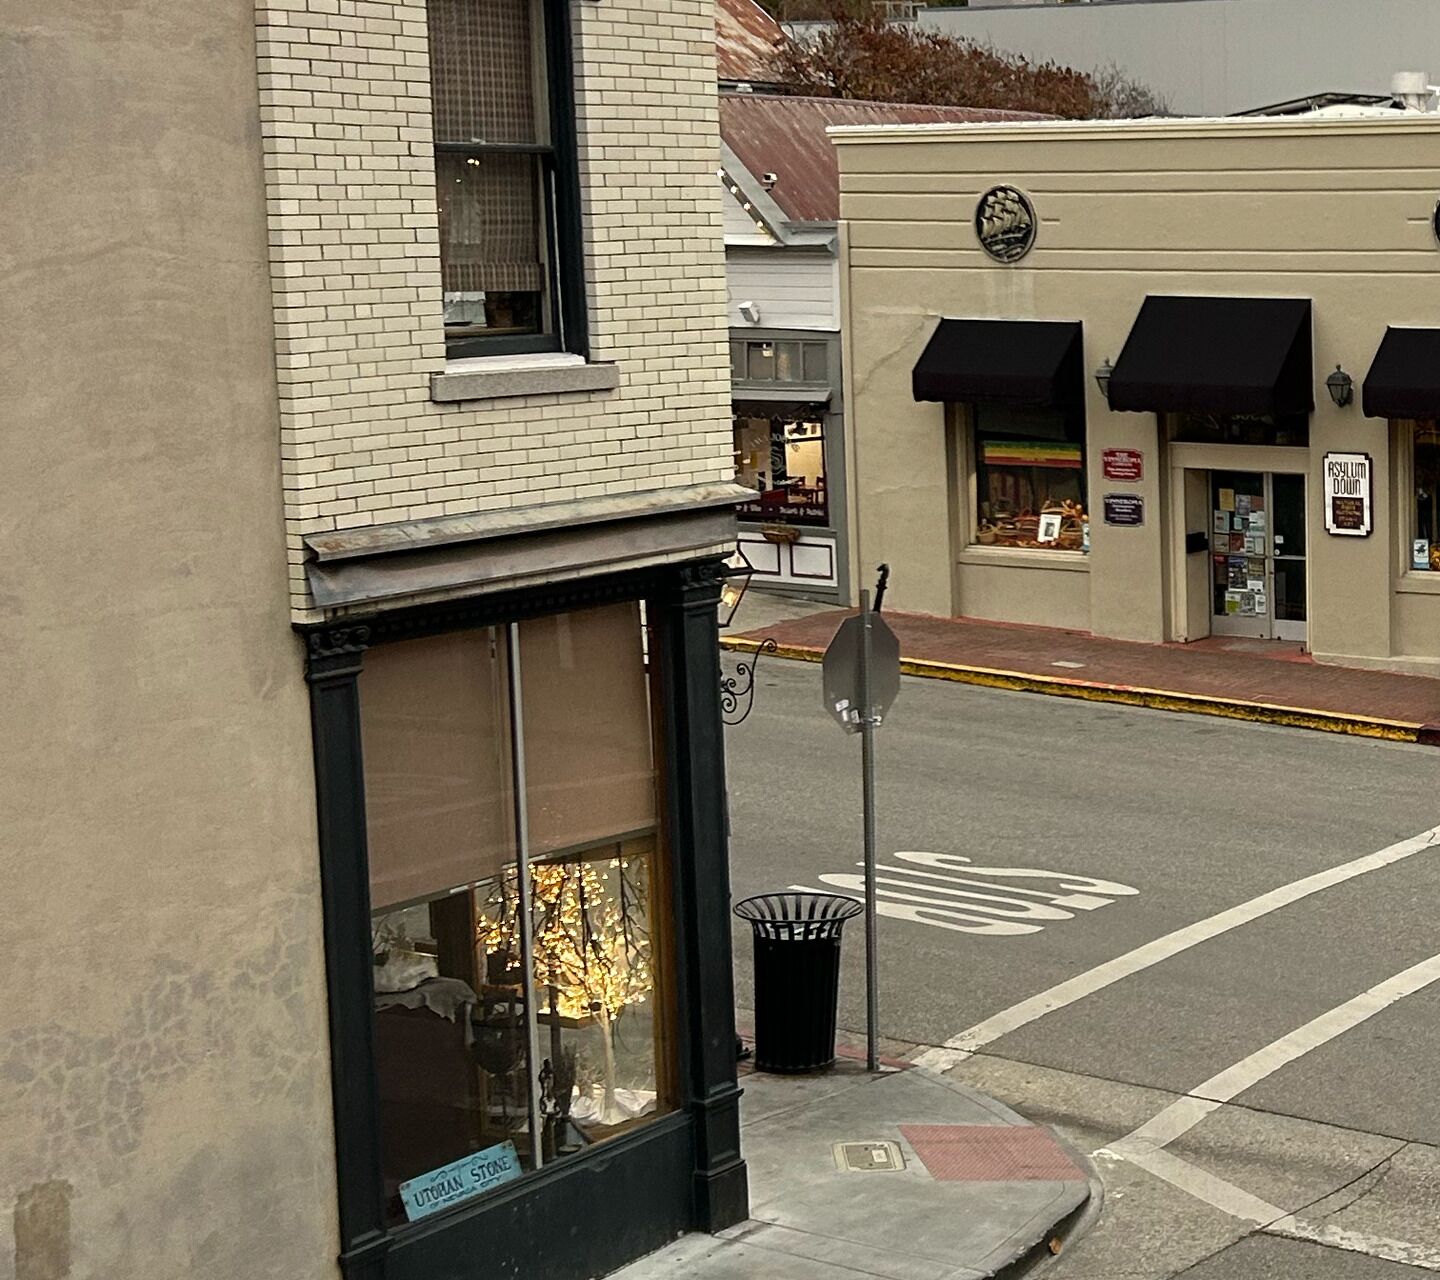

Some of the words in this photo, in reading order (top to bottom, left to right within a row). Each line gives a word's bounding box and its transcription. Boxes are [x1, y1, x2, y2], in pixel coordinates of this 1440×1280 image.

[1328, 461, 1367, 479] ASYLUM
[1333, 478, 1361, 495] DOWN
[786, 851, 1140, 936] STOP
[471, 1156, 512, 1183] STONE
